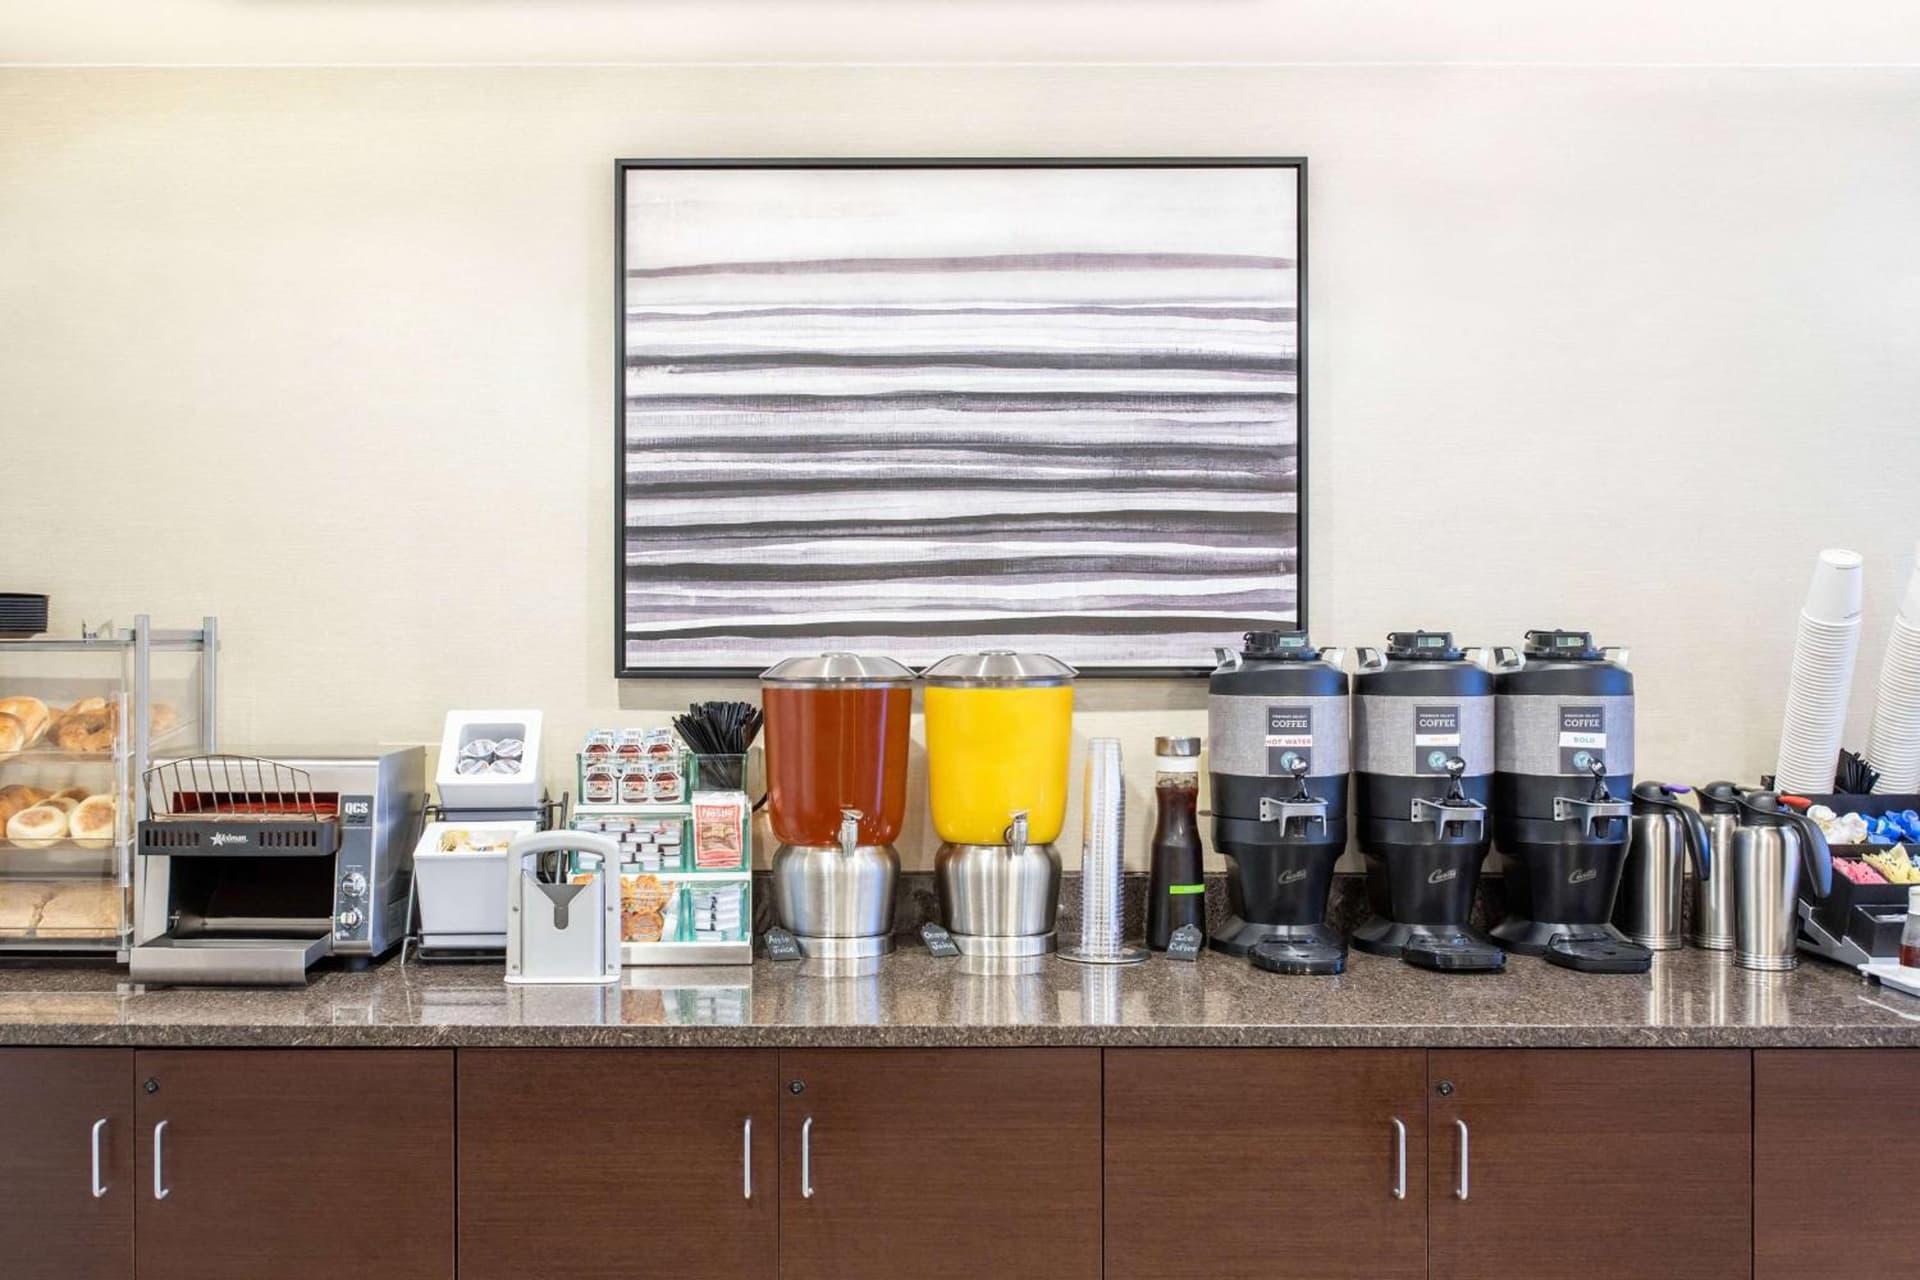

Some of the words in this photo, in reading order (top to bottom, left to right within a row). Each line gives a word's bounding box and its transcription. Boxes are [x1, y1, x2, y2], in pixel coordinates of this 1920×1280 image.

[1271, 719, 1308, 728] COFFEE
[1419, 718, 1456, 728] COFFEE
[1564, 718, 1600, 728] COFFEE
[1264, 738, 1282, 746] HOT
[1284, 738, 1312, 746] WATER
[1573, 736, 1596, 744] BOLD
[344, 802, 369, 815] QCS
